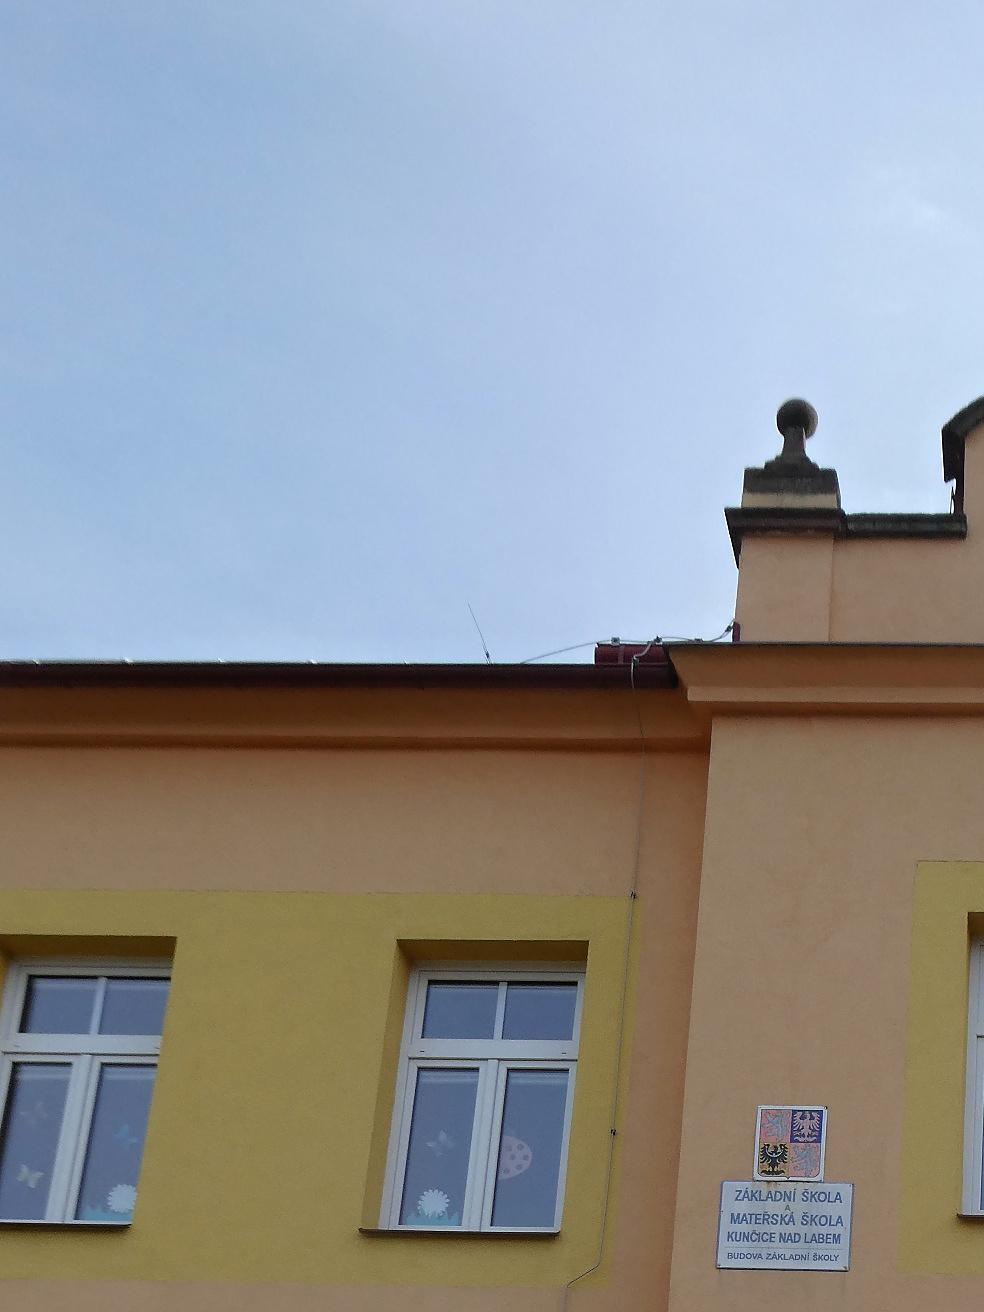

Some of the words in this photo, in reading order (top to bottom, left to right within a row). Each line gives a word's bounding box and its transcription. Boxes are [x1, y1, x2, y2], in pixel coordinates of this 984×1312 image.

[735, 1188, 797, 1202] ZÁKLADNÍ
[801, 1188, 843, 1203] ŠKOLA
[730, 1211, 796, 1226] MATEŘSKÁ
[800, 1212, 844, 1227] ŠKOLA
[727, 1230, 776, 1243] KUNČICE
[779, 1233, 801, 1244] NAD
[804, 1233, 841, 1245] LABEM
[727, 1252, 763, 1260] BUDOVA
[766, 1251, 810, 1261] ZÁKLADNÍ
[813, 1253, 839, 1262] ŠKOLY
